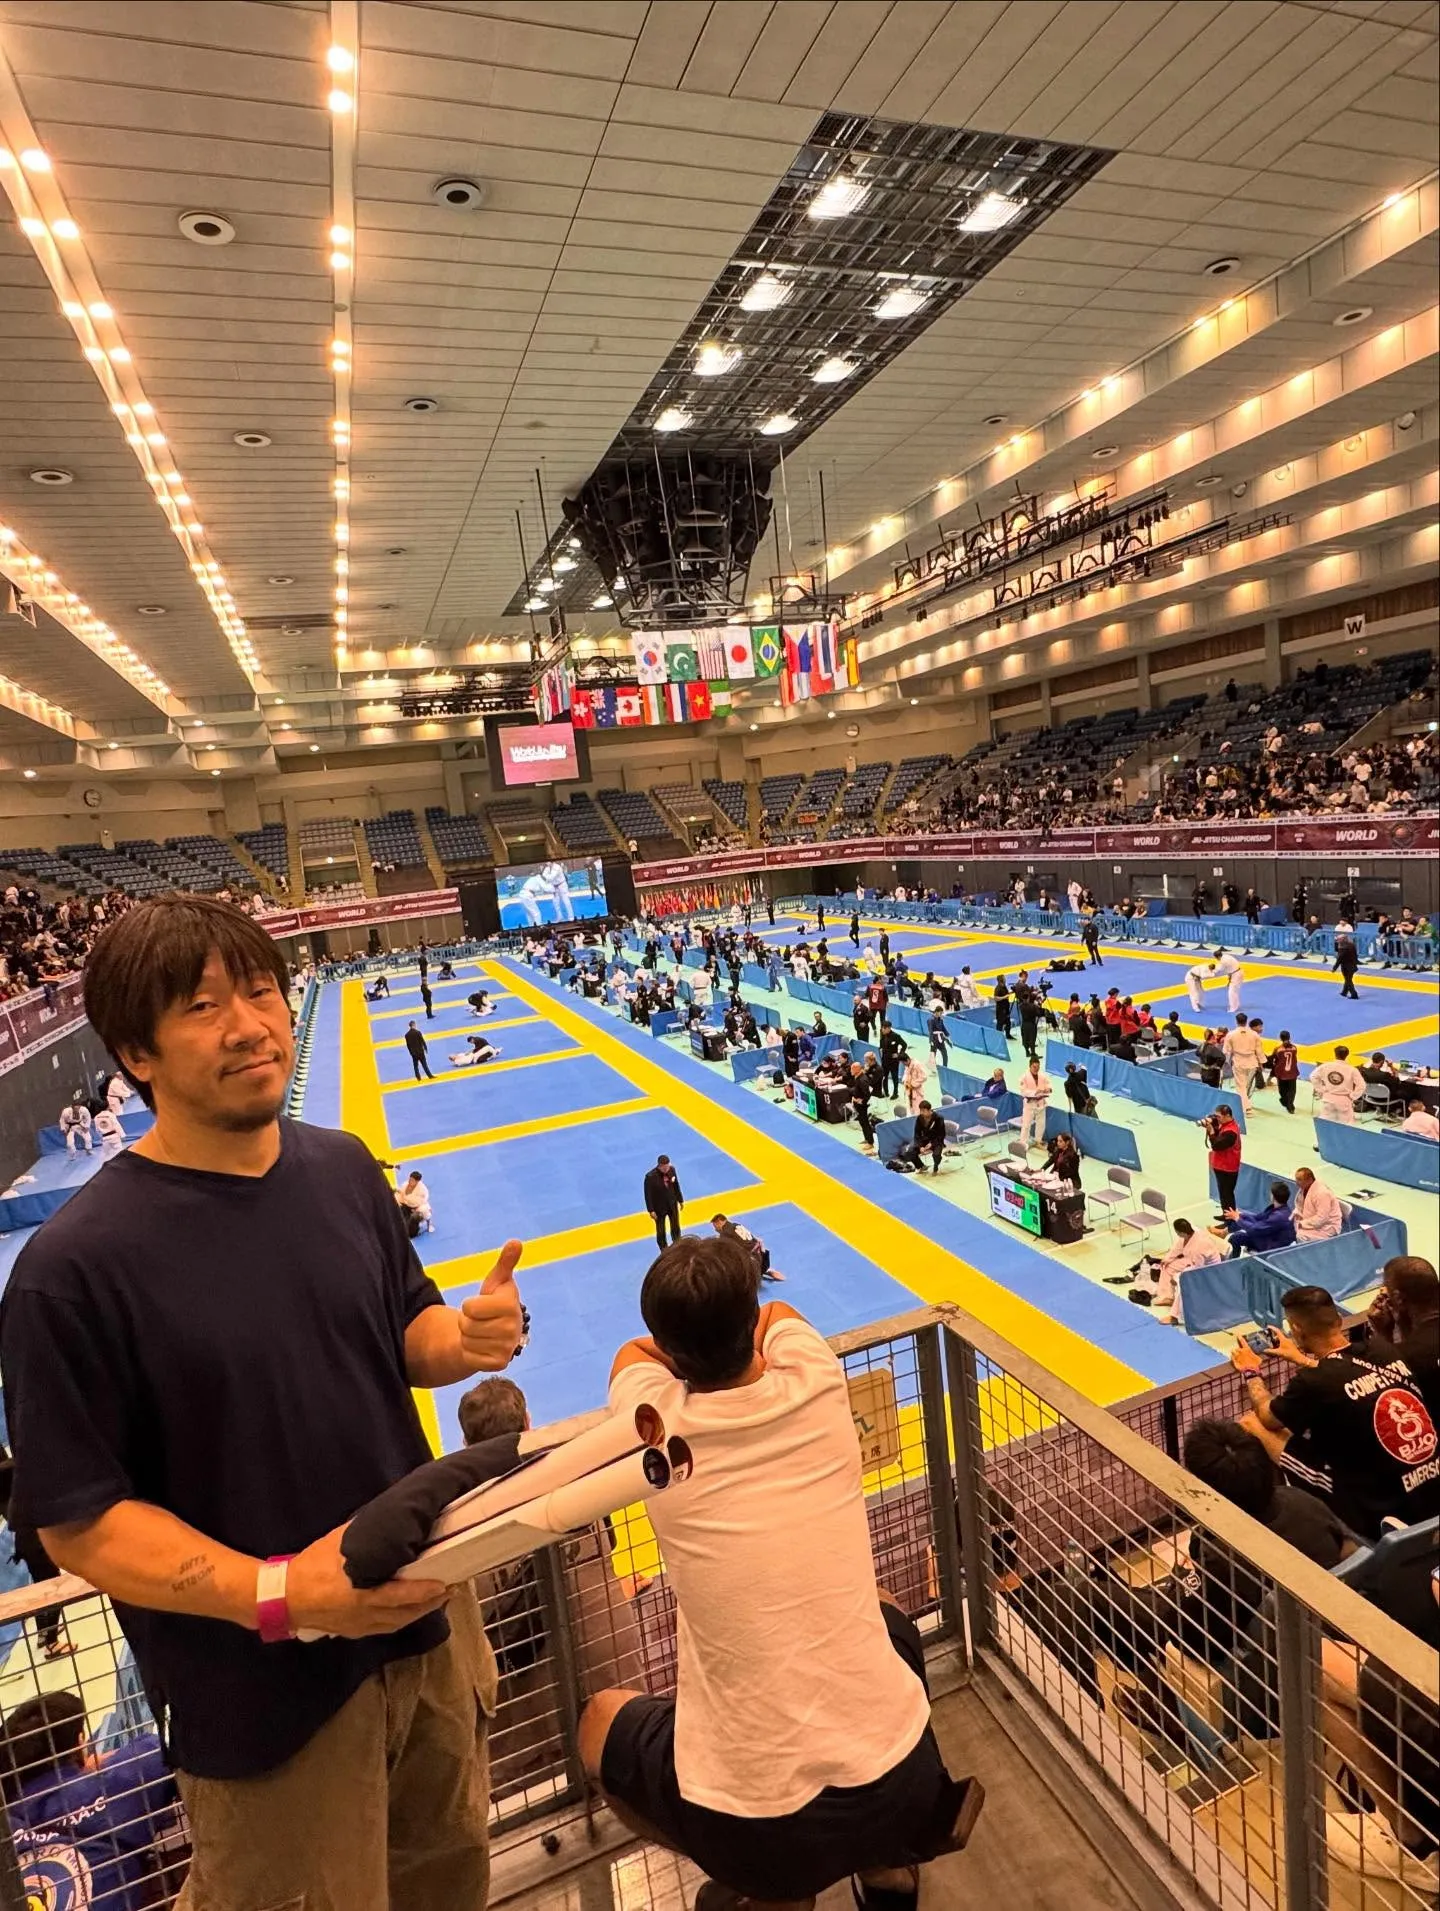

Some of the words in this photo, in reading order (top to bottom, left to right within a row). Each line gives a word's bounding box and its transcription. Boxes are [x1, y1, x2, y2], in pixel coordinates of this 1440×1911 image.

[1346, 620, 1363, 635] W
[1133, 836, 1161, 846] WORLD
[1191, 835, 1220, 844] JIU-JITSU
[1221, 834, 1272, 843] CHAMPIONSHIP
[1335, 829, 1378, 842] WORLD
[999, 841, 1019, 850] WORLD
[798, 850, 822, 859] WORLD
[666, 864, 690, 875] WORLD
[338, 907, 366, 919] WORLD
[1283, 1051, 1293, 1072] 7
[823, 1094, 831, 1105] 13
[1045, 1198, 1058, 1214] 14
[1352, 1357, 1377, 1372] TOUR
[1398, 1432, 1435, 1457] BJJO
